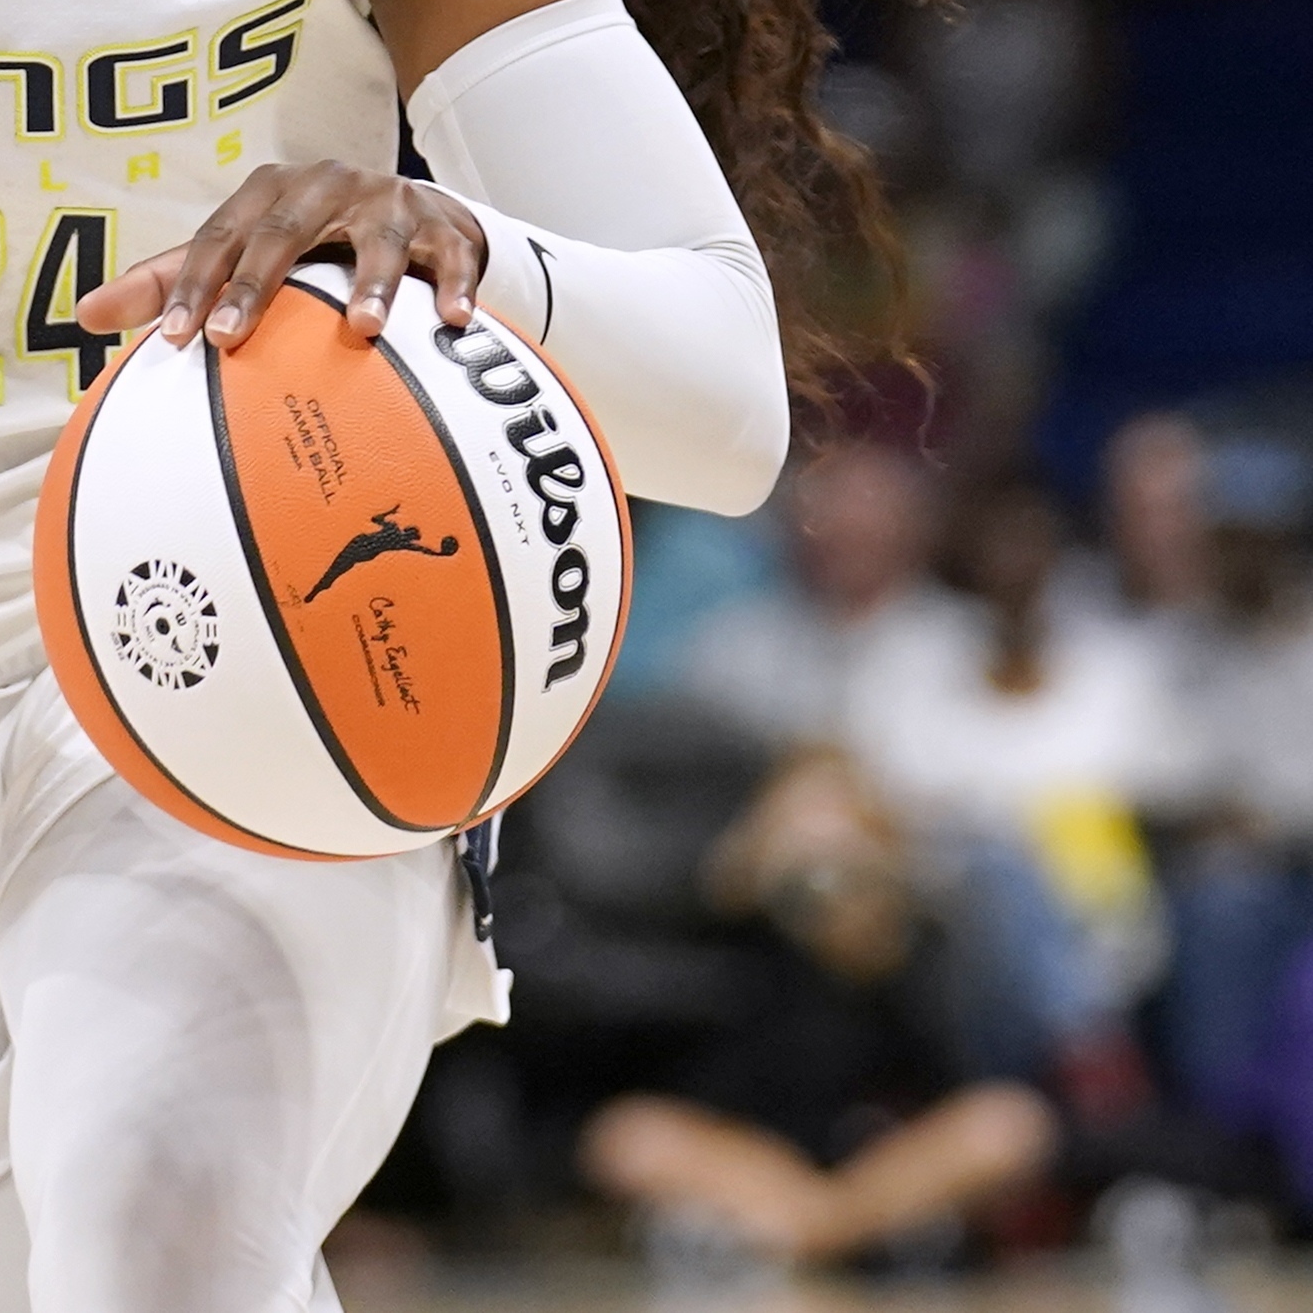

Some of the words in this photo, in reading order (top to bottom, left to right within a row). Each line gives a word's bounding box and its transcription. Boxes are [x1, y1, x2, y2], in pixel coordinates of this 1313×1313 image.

[284, 393, 316, 449] GAME
[308, 451, 336, 506] BALL
[306, 398, 348, 486] OFFICIAL
[429, 313, 593, 694] Wilson
[488, 450, 513, 495] EVO
[510, 503, 531, 547] NXT
